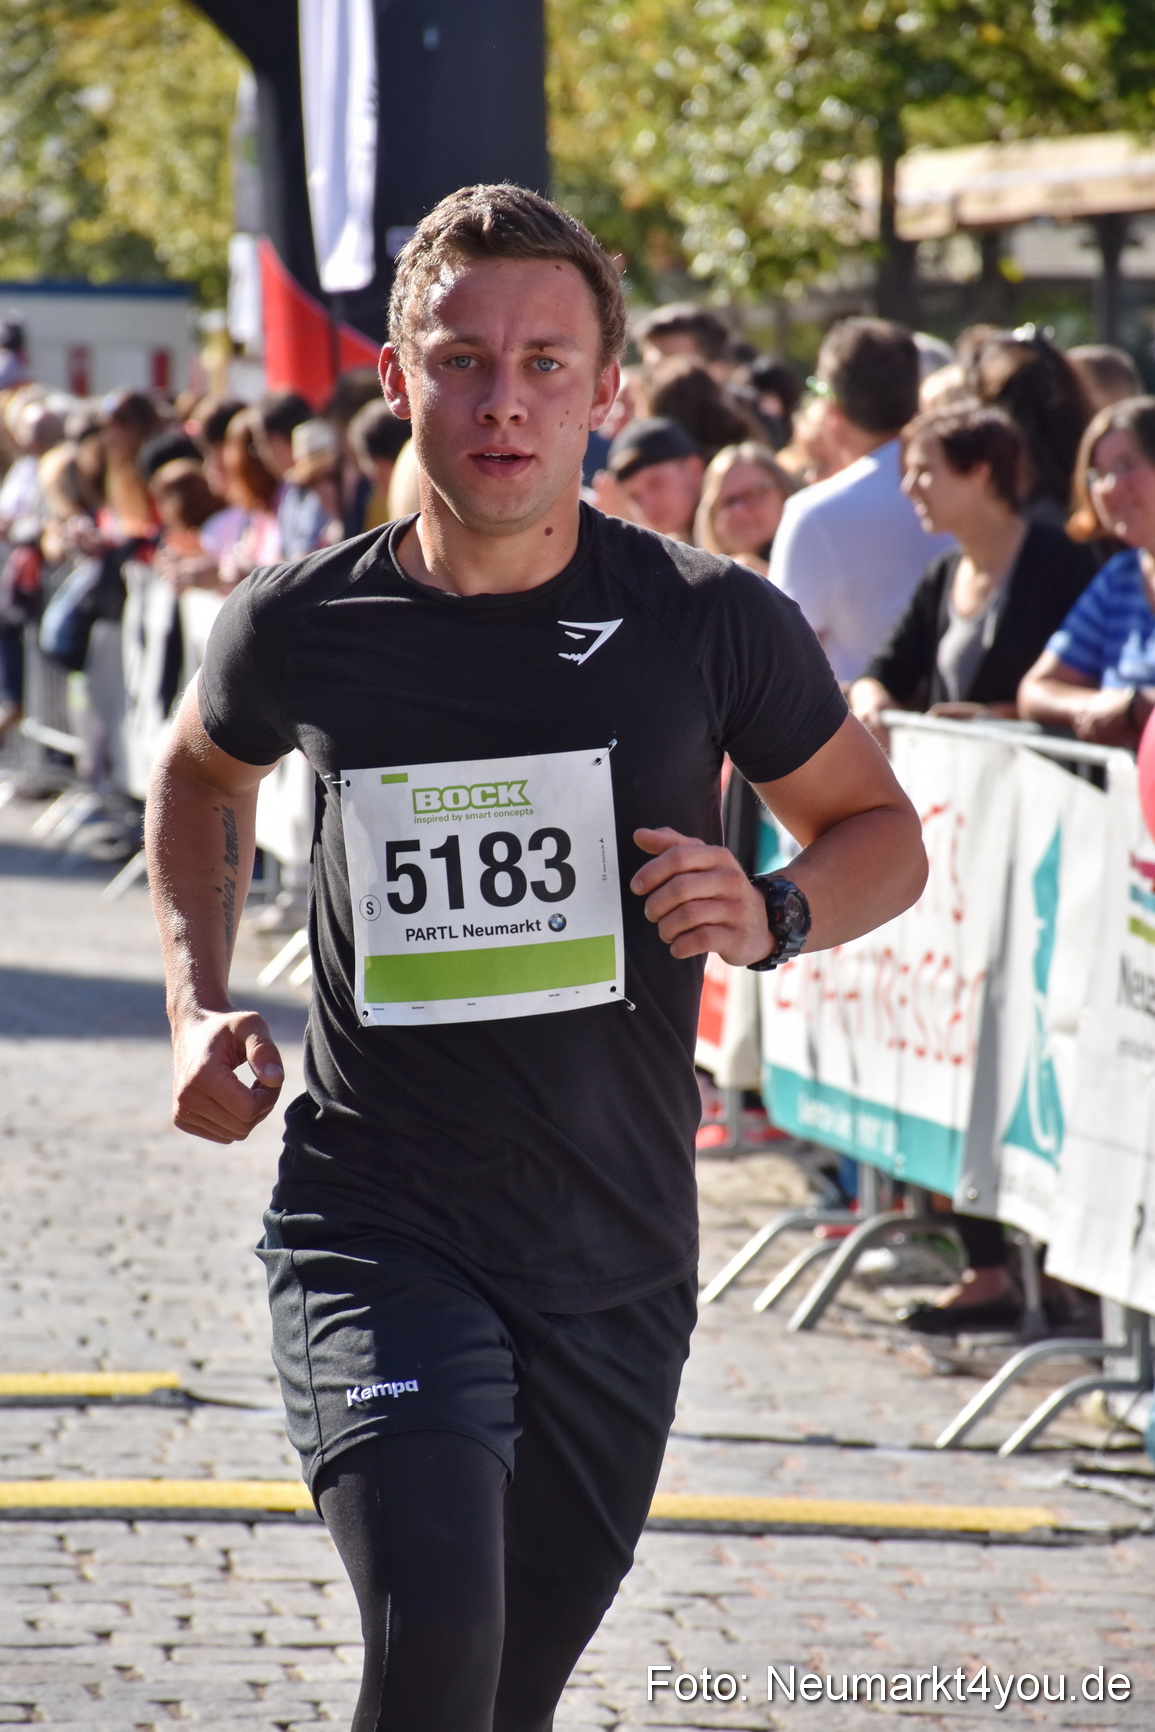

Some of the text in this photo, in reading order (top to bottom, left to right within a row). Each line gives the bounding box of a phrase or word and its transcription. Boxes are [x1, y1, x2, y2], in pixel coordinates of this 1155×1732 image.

[411, 780, 532, 814] BOCK
[413, 808, 534, 825] inspired by smart concepts
[385, 827, 577, 914] 5183
[366, 902, 375, 915] S
[405, 925, 458, 942] PARTL
[462, 919, 542, 938] Neumarkt
[346, 1379, 419, 1407] Kempa
